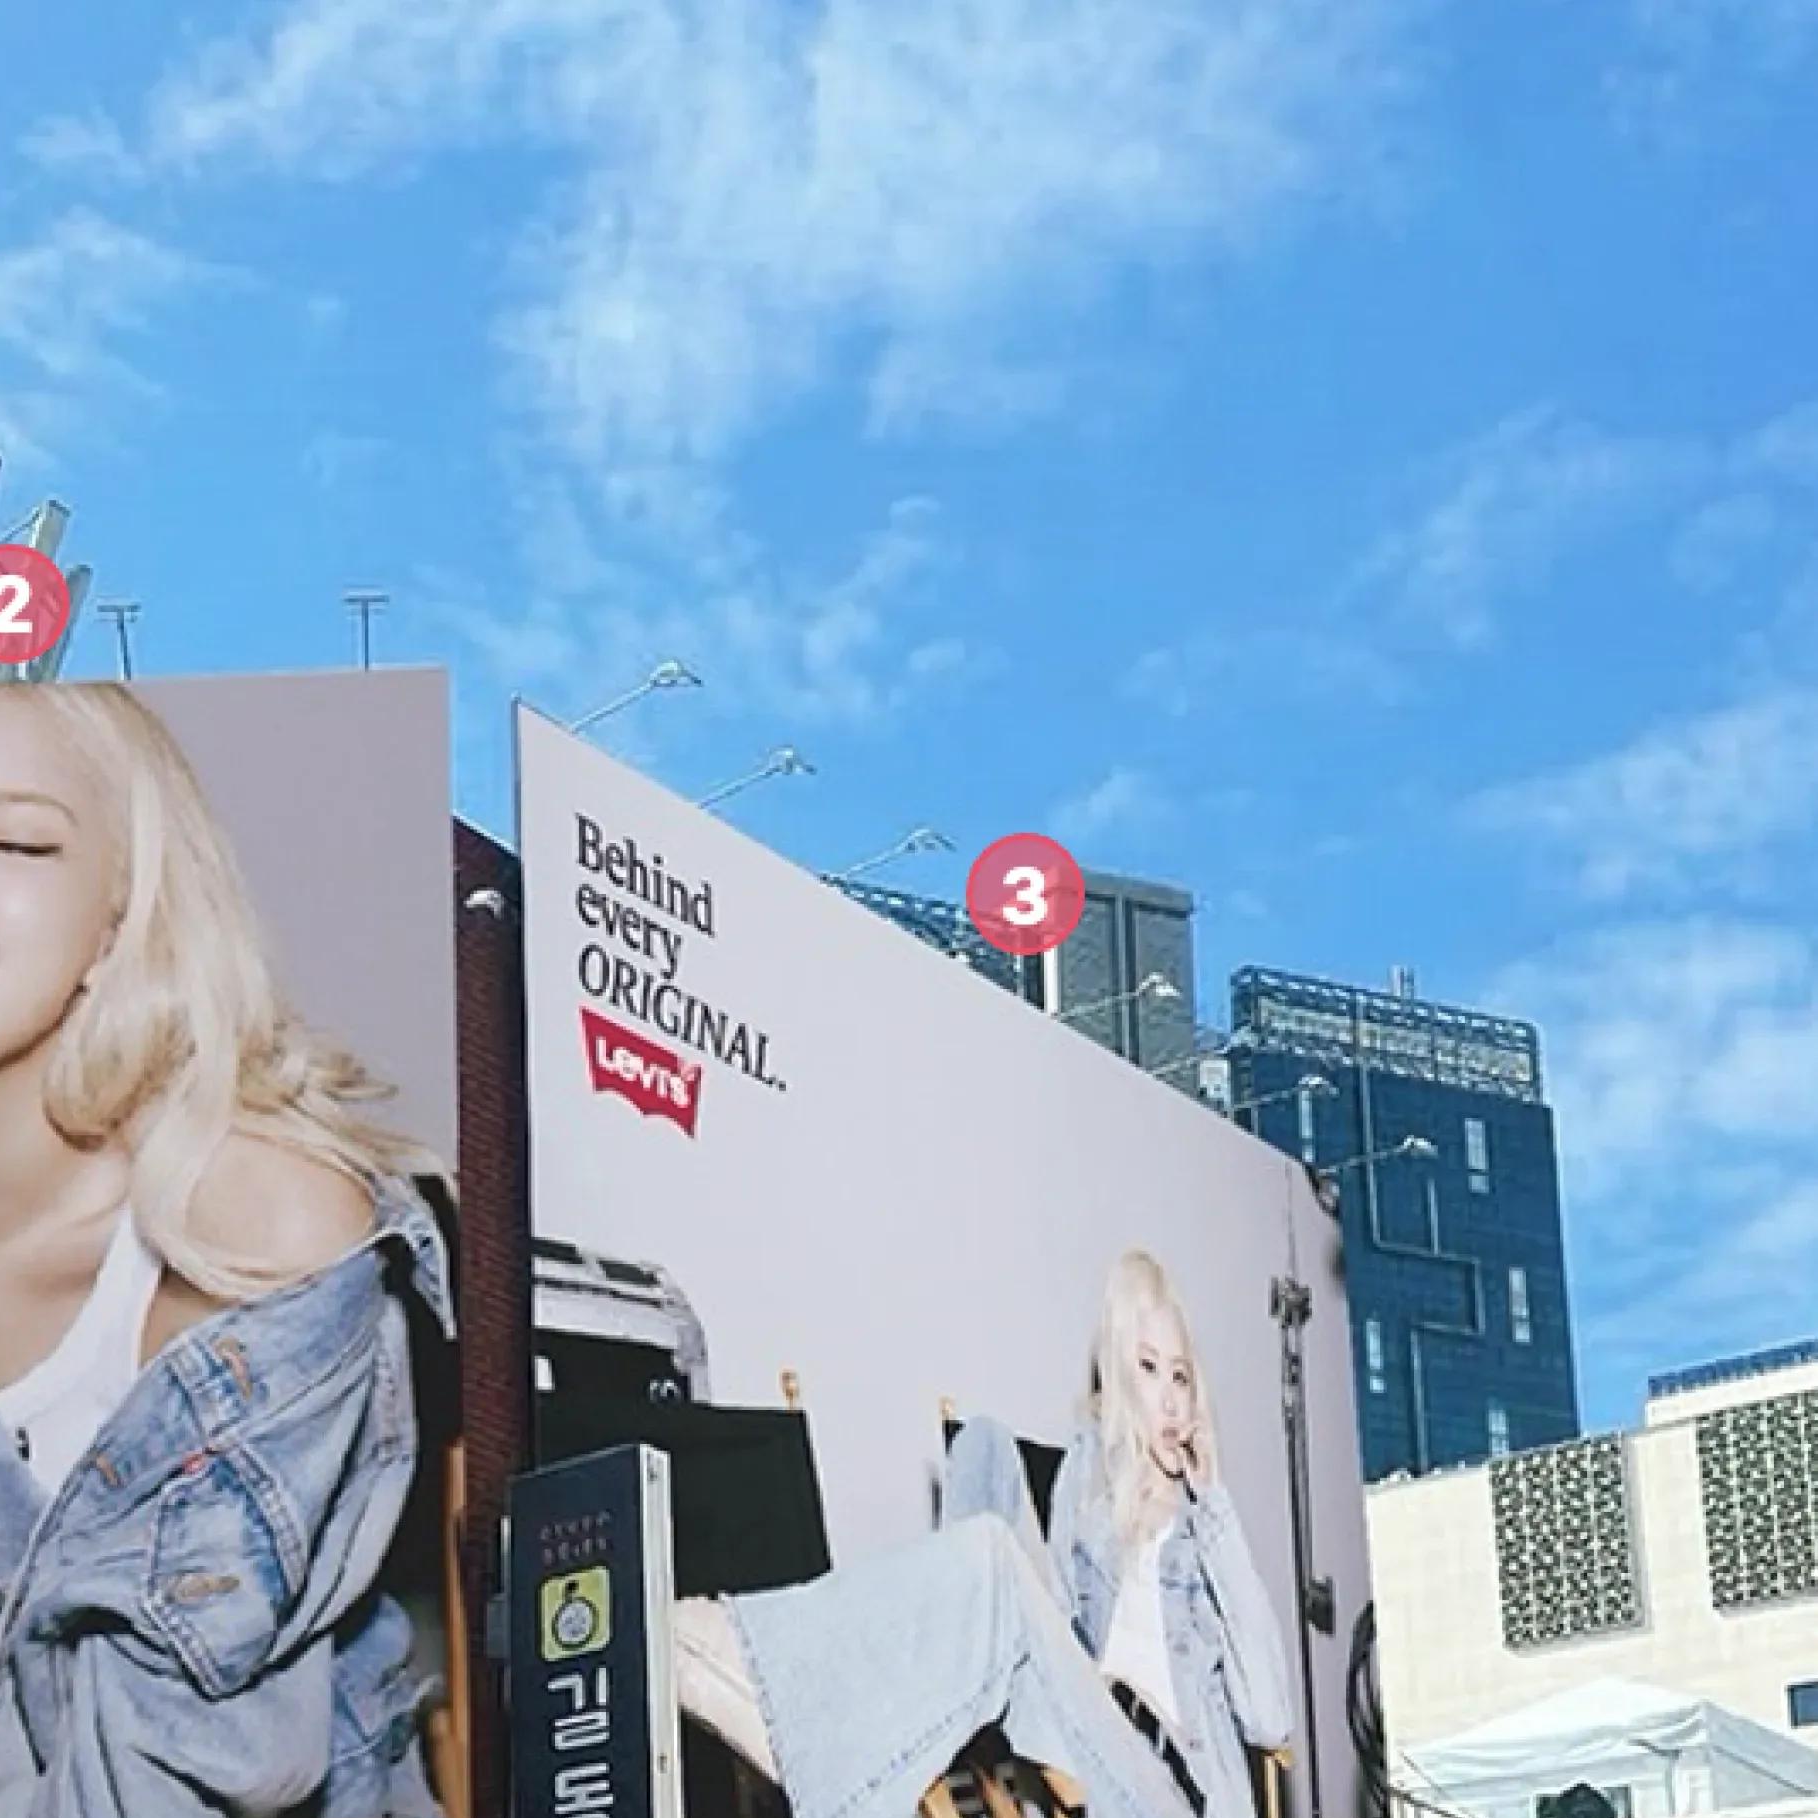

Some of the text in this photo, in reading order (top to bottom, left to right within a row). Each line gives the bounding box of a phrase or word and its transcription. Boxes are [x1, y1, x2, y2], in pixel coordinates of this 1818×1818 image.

[575, 812, 715, 938] Behind
[575, 883, 682, 979] every
[578, 943, 786, 1091] ORIGINAL.
